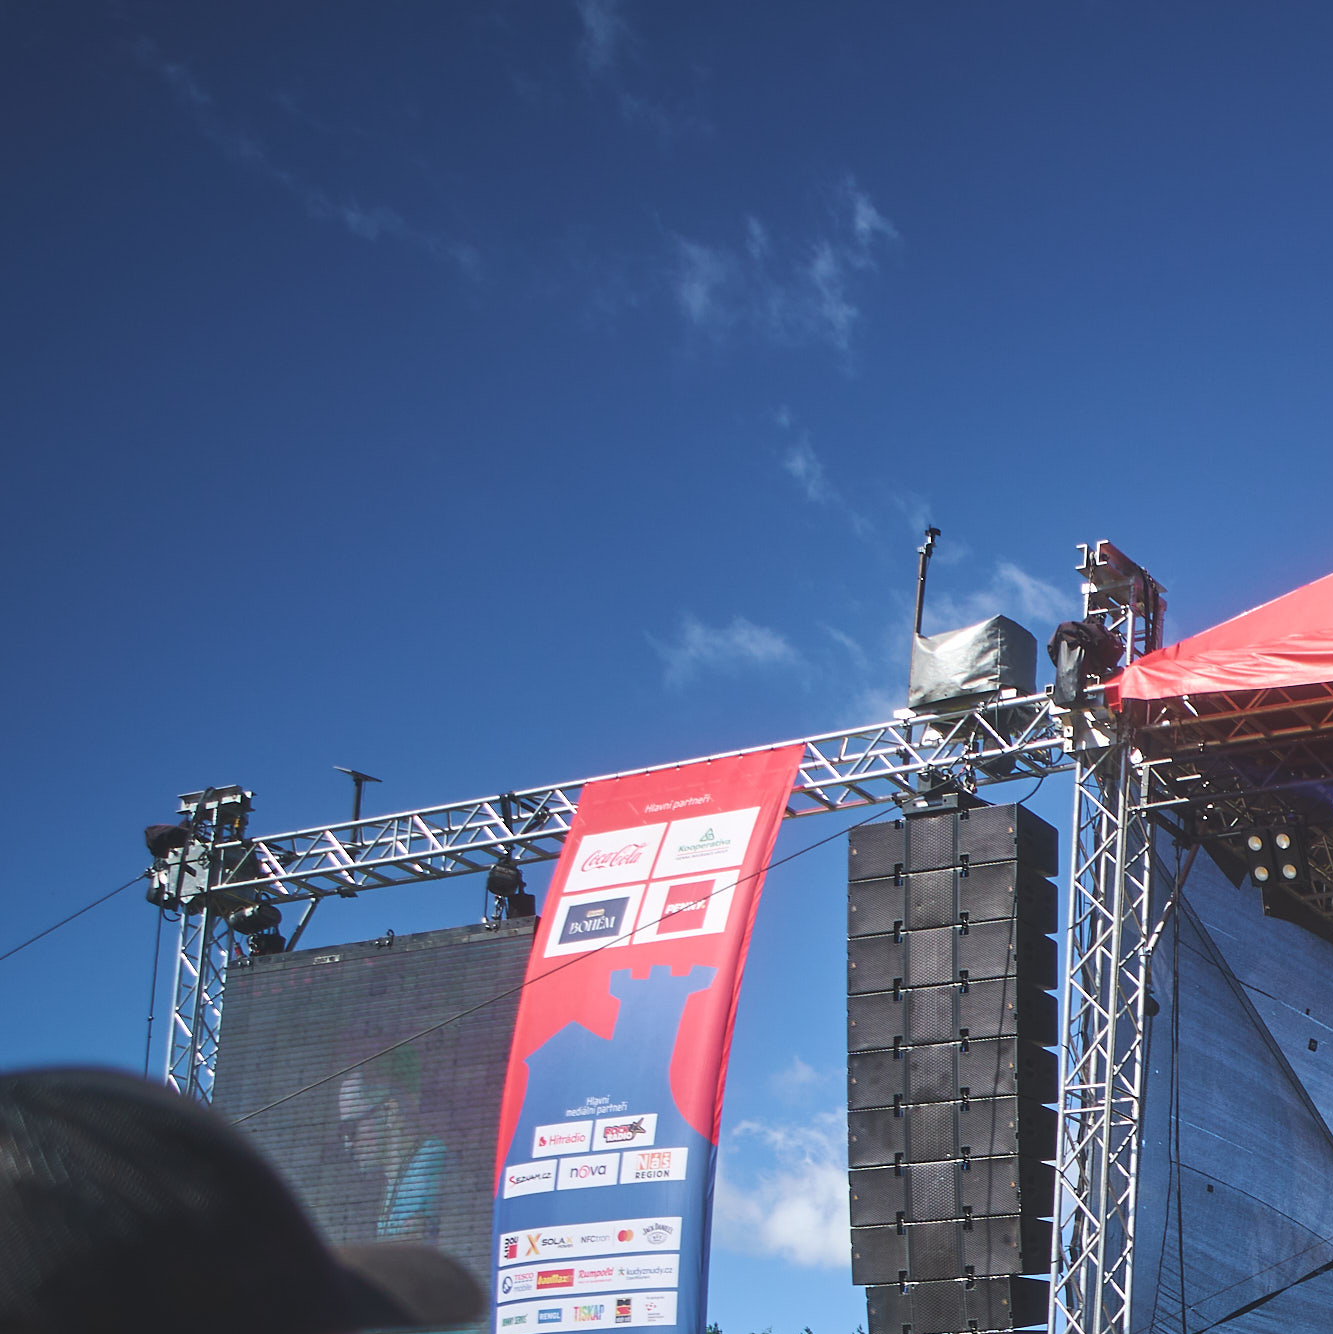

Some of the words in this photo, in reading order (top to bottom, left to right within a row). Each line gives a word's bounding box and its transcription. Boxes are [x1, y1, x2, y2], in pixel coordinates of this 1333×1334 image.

[645, 801, 672, 814] Hlavní
[581, 842, 648, 873] Coca-Cola
[569, 915, 616, 935] BOHÉM
[586, 1094, 611, 1106] Hlavní
[549, 1132, 586, 1146] Hitrádio
[635, 1170, 670, 1179] REGION
[514, 1272, 535, 1281] TESCO
[573, 1304, 605, 1322] TISKAP
